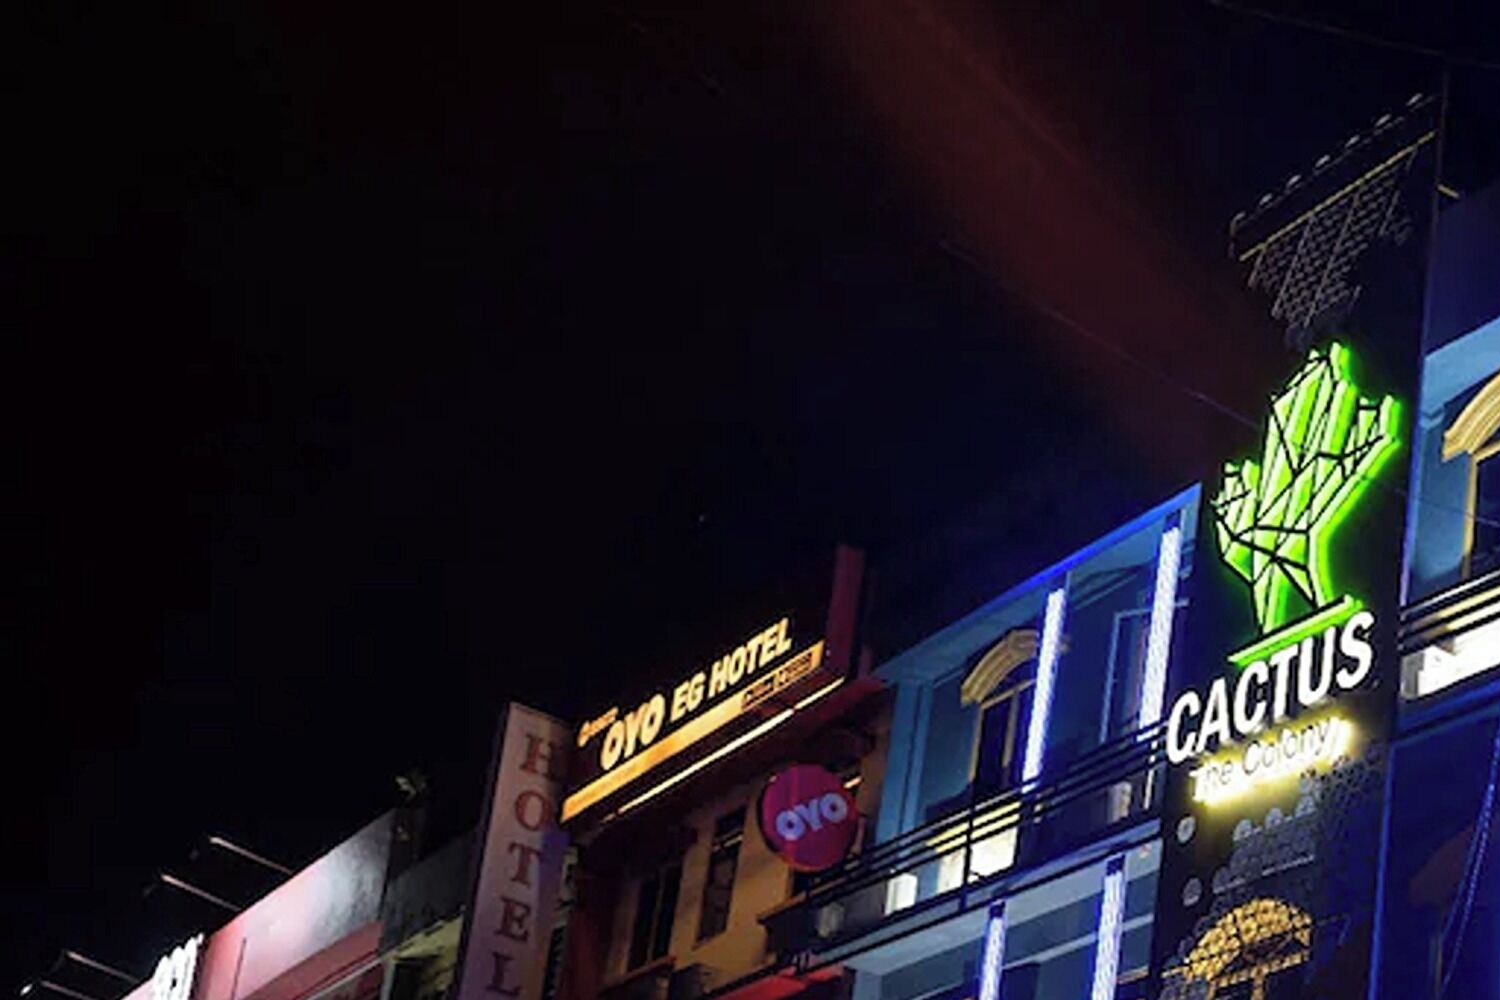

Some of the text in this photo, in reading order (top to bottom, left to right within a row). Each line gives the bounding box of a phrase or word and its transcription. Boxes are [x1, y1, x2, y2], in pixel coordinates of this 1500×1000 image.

[600, 694, 666, 771] OYO
[670, 671, 707, 722] EG
[707, 616, 793, 699] HOTEL
[1167, 609, 1375, 765] CACTUS
[1241, 717, 1339, 776] Colony
[486, 733, 567, 998] HOTEL
[776, 791, 849, 841] OYO
